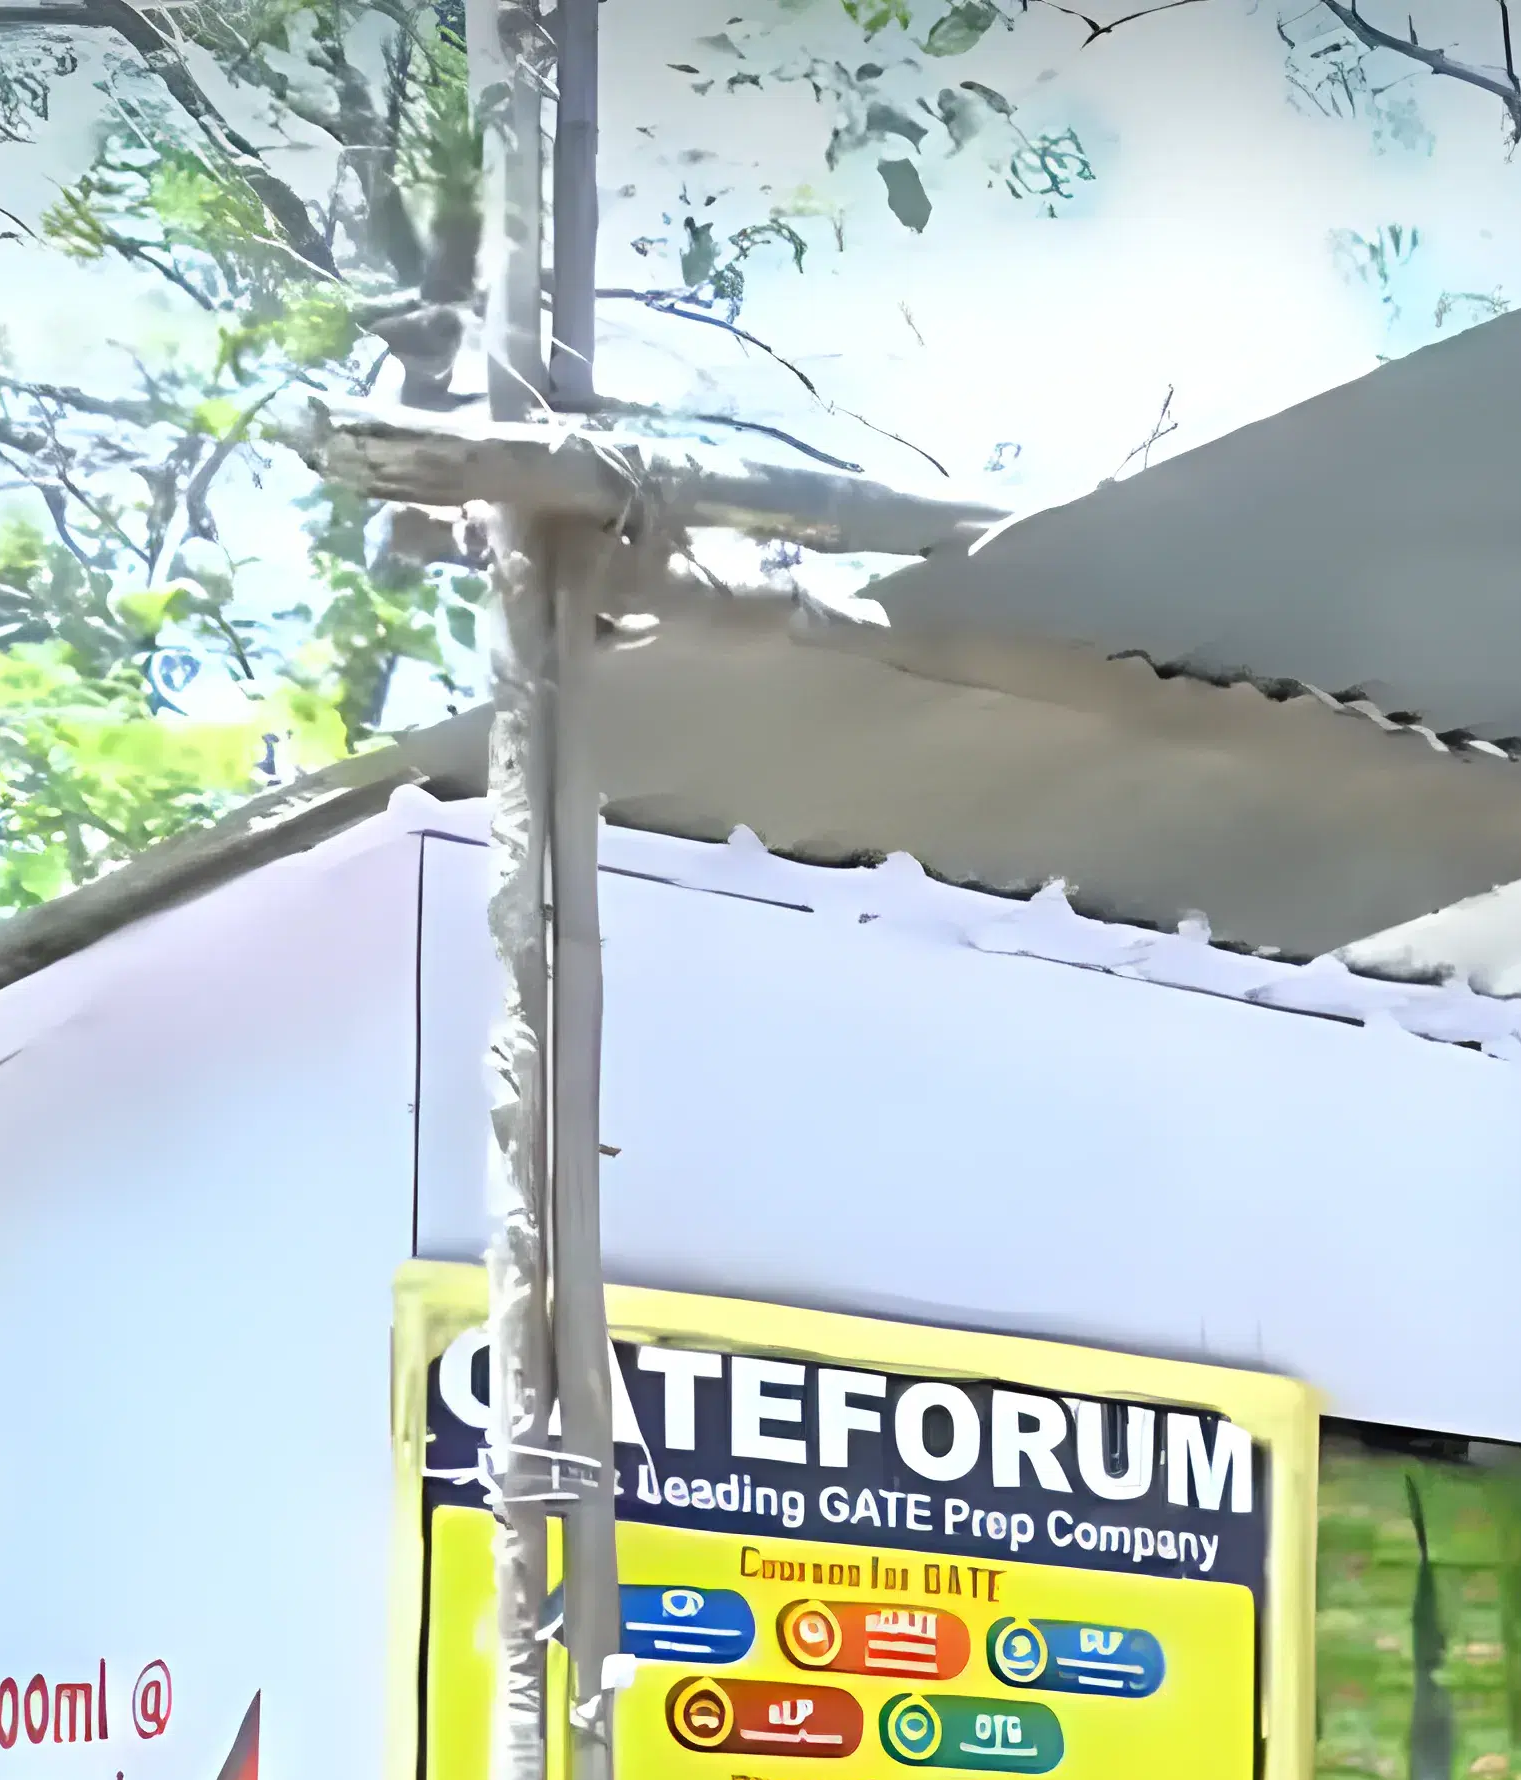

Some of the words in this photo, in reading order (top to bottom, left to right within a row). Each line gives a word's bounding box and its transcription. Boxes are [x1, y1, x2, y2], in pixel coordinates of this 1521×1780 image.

[637, 1464, 805, 1527] Leading
[819, 1486, 933, 1531] GATE
[1047, 1509, 1219, 1571] Company
